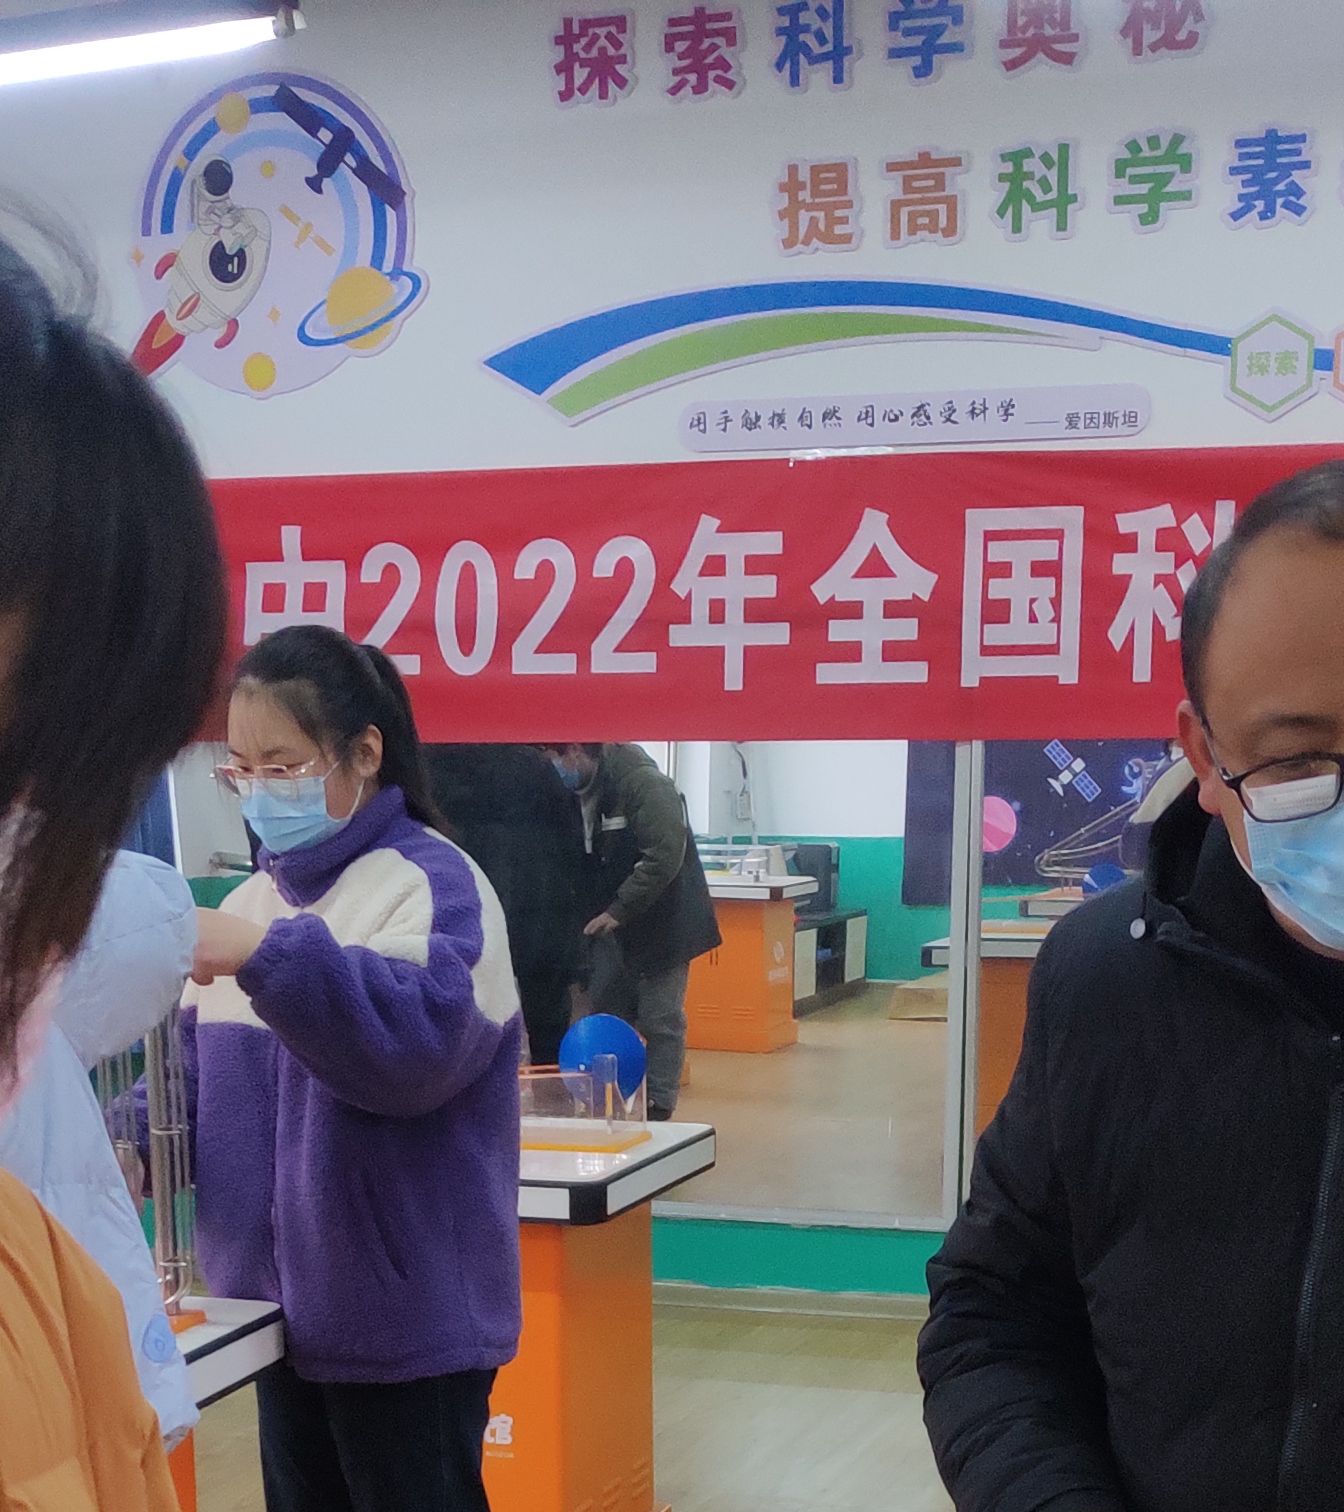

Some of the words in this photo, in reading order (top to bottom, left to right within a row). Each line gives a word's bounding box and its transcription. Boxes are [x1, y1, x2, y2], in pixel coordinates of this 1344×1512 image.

[554, 0, 1206, 102] 探索科学奥秘
[1246, 347, 1299, 378] 探索
[688, 405, 842, 434] 用手触摸自然
[856, 397, 1016, 428] 用心感受科学
